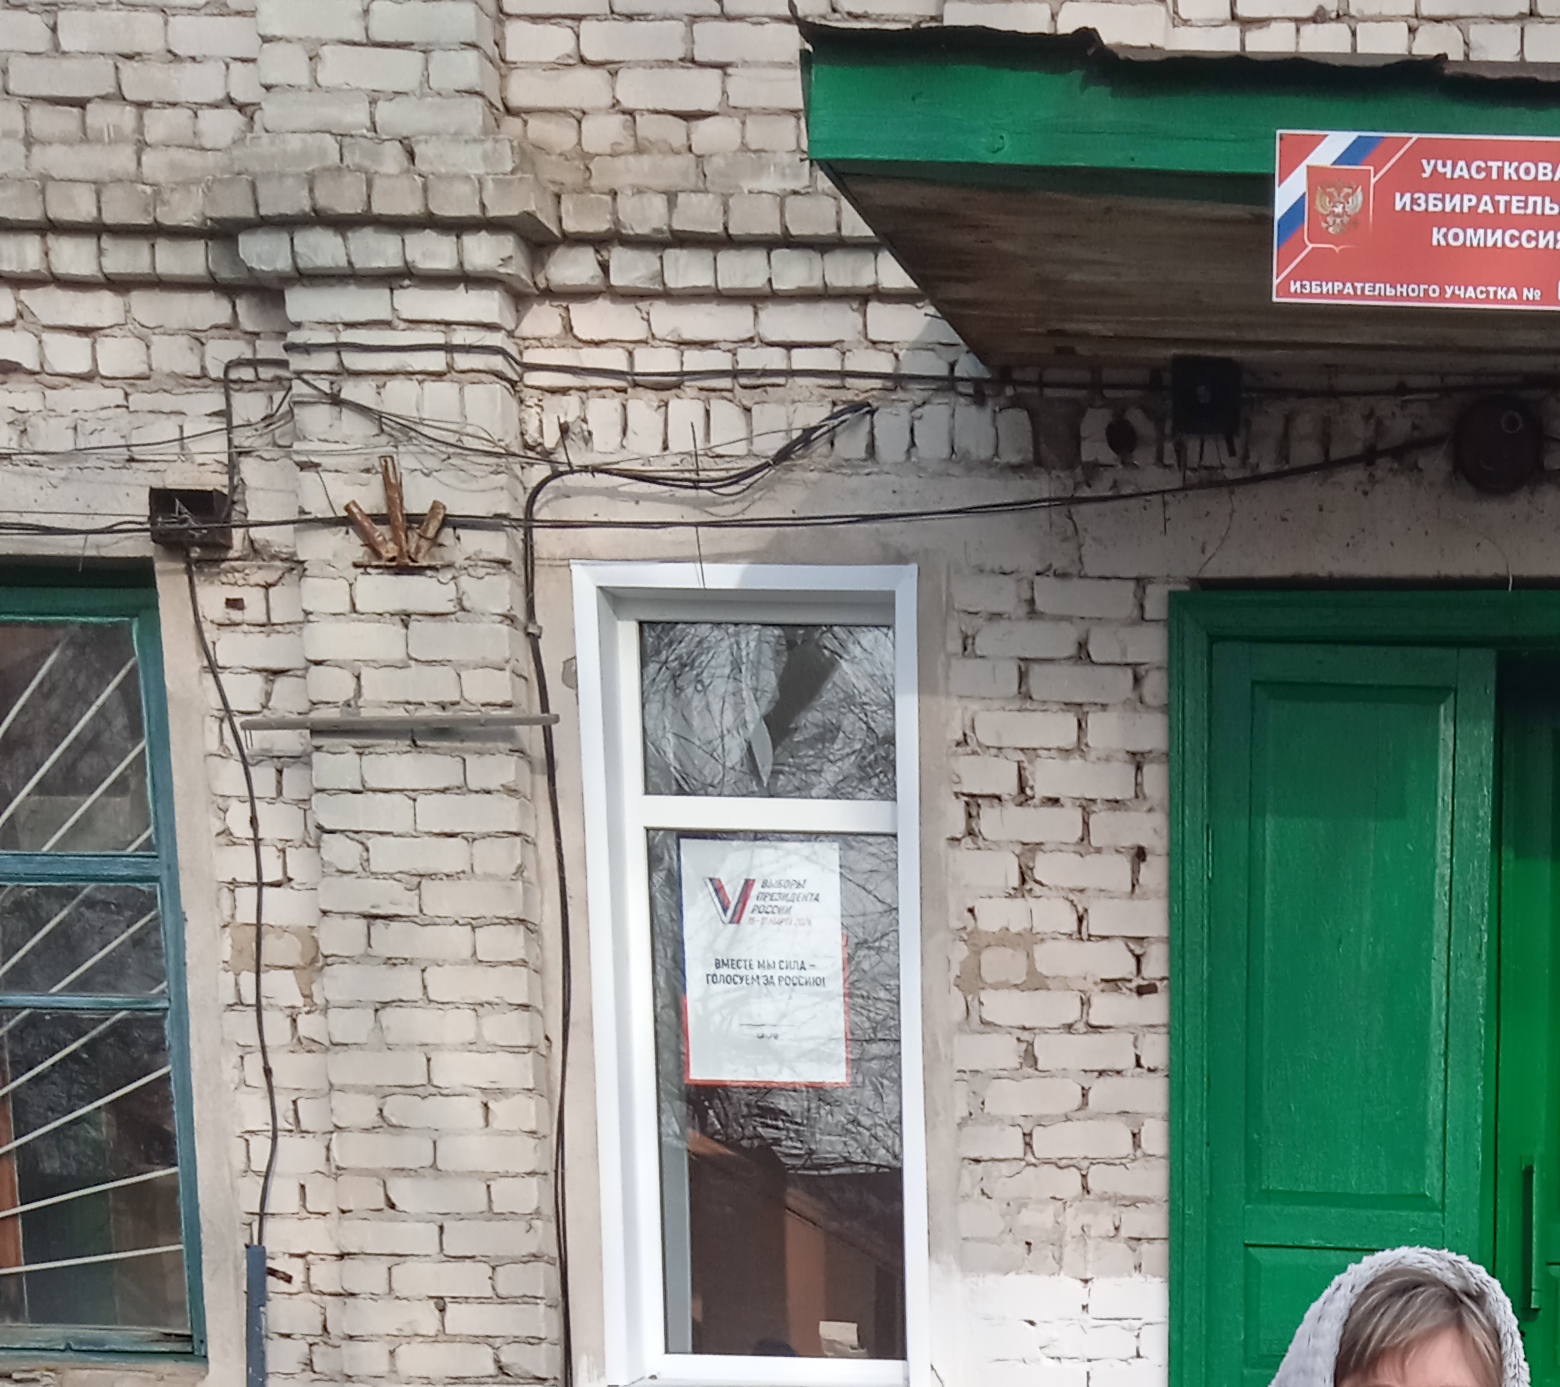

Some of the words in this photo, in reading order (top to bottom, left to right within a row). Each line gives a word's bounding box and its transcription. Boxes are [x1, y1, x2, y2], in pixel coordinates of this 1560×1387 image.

[1289, 279, 1440, 298] ИЗБИРАТЕЛЬНОГО
[1444, 284, 1519, 300] УЧАСТКА
[761, 878, 807, 889] ВЫБОРЫ
[756, 891, 820, 903] ПРЕЗИДЕНТА
[751, 904, 792, 915] РОССИИ
[714, 958, 754, 970] ВМЕСТЕ
[757, 960, 776, 971] МЫ
[778, 960, 807, 971] СИЛА
[705, 973, 760, 985] ГОЛОСУЕМ
[762, 975, 775, 986] ЗА
[777, 976, 826, 987] РОССИЮ!
